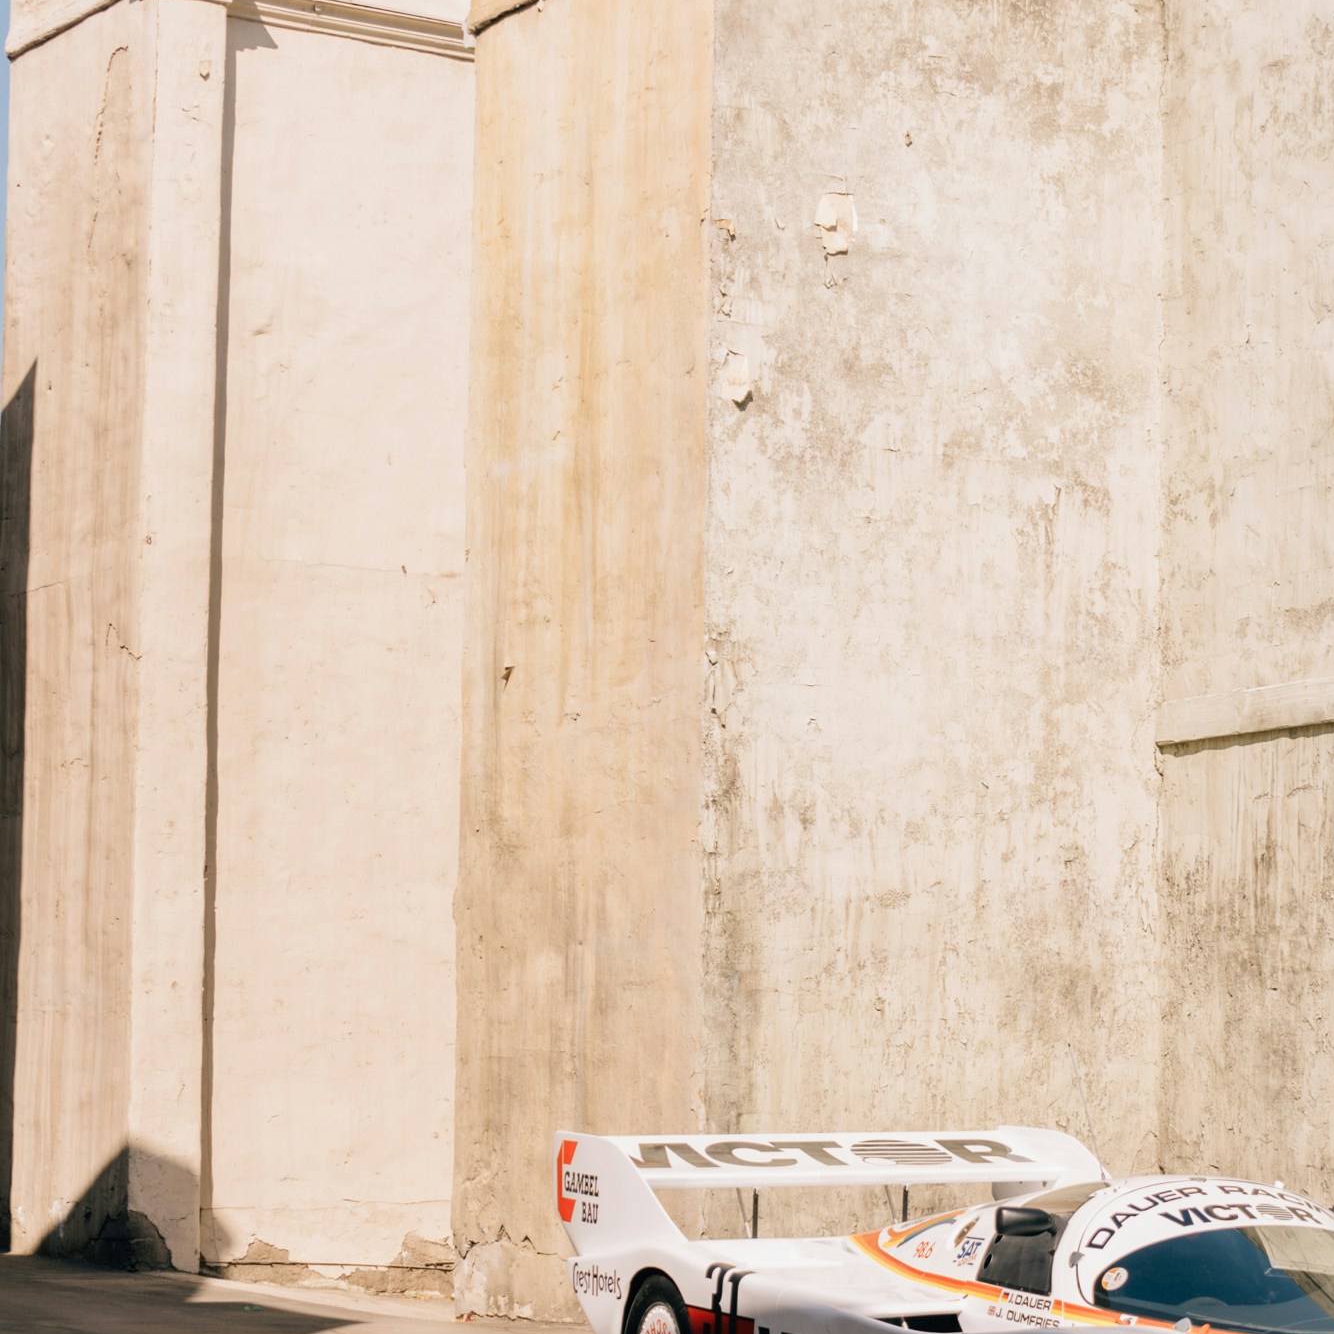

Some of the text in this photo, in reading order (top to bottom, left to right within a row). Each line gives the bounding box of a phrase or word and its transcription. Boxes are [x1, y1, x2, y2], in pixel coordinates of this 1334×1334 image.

[628, 1139, 1035, 1168] VICTOR
[564, 1171, 600, 1197] GAMBEL
[582, 1201, 599, 1224] BAU
[1086, 1185, 1208, 1250] DAUER
[1158, 1203, 1323, 1227] VICTOR
[957, 1240, 982, 1259] SAT
[592, 1265, 622, 1300] Hotels
[1006, 1310, 1060, 1328] DUMFRIES
